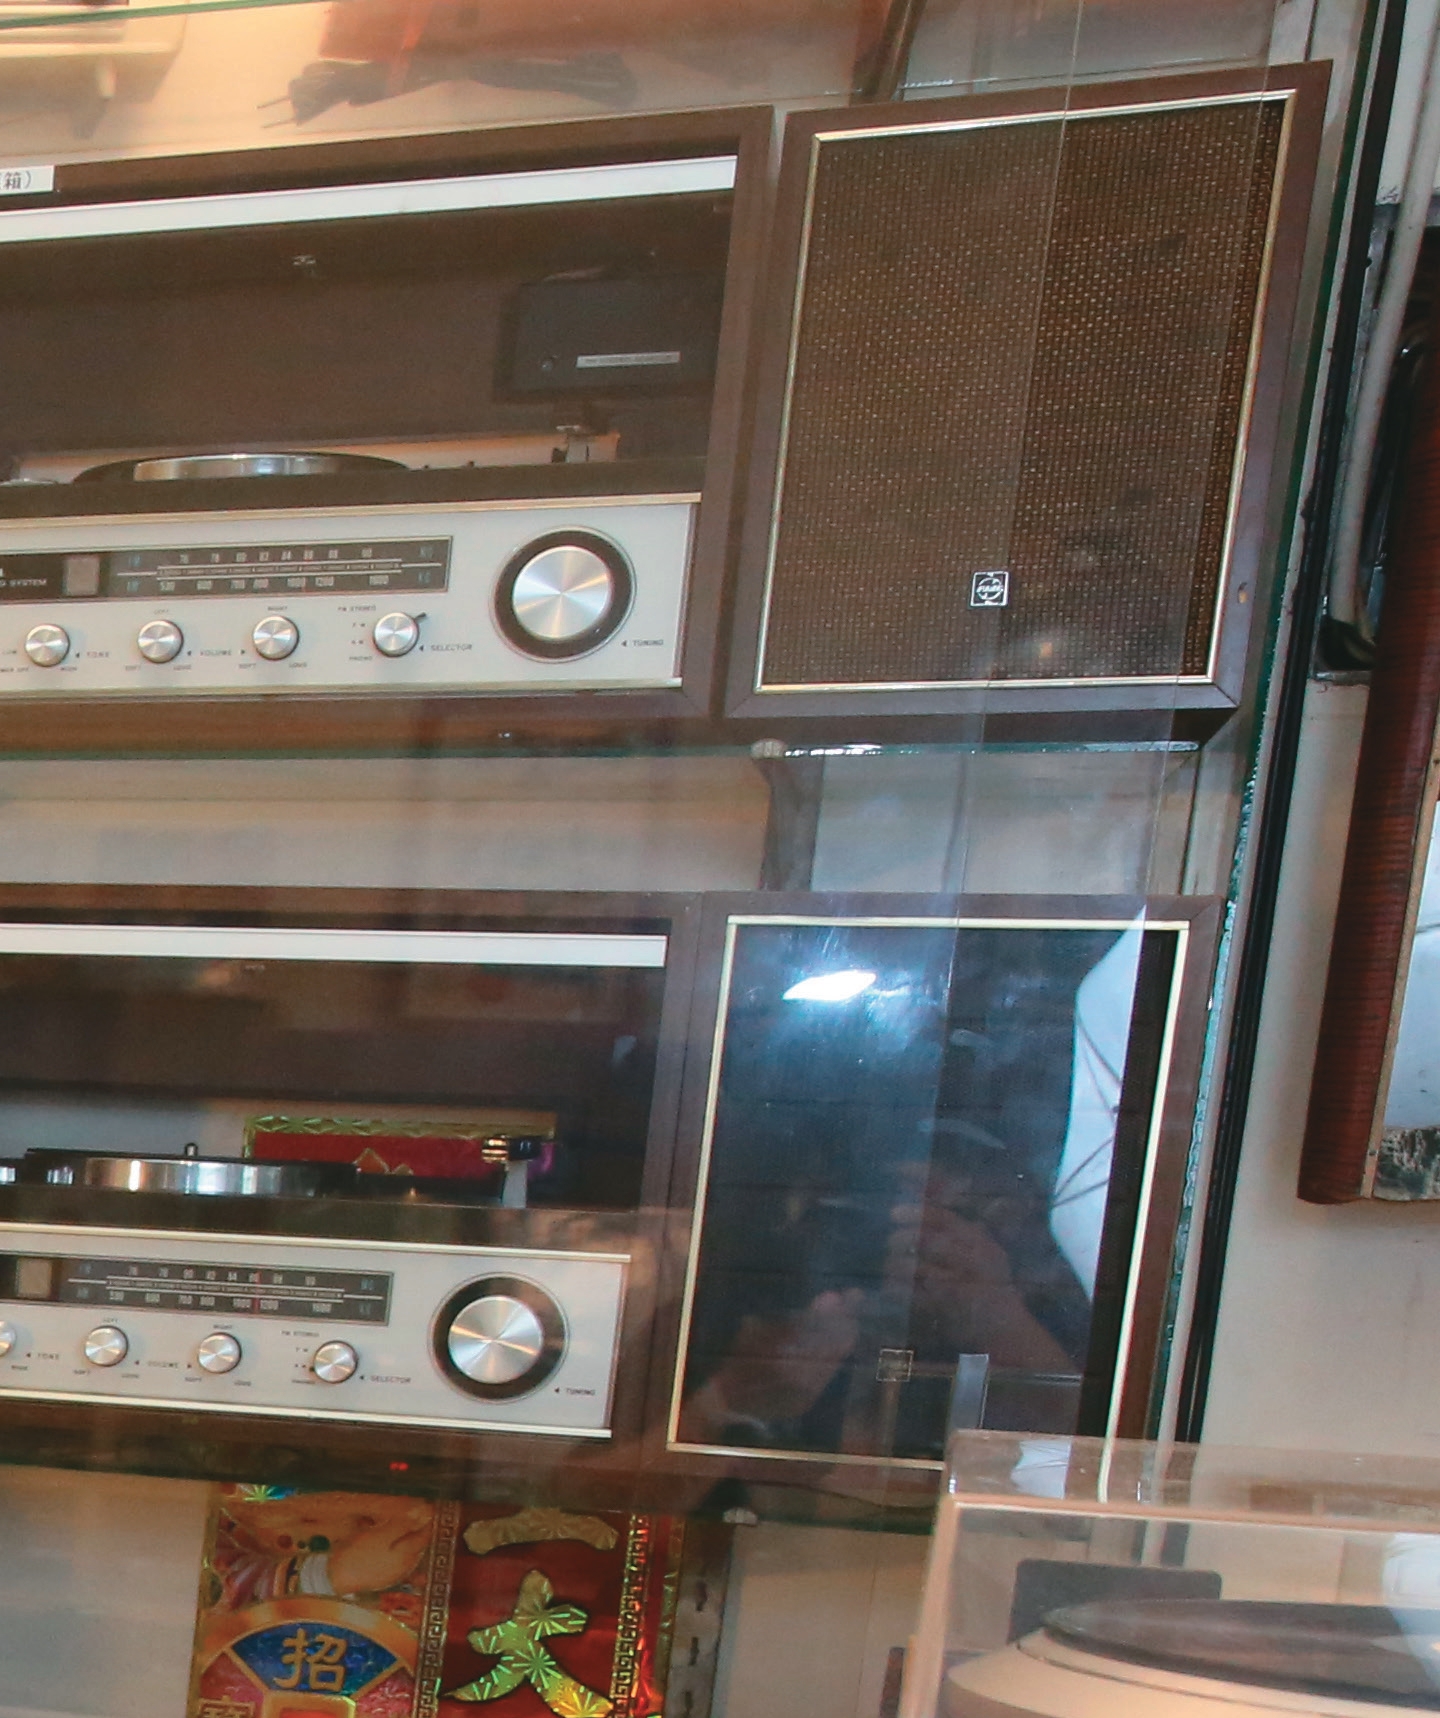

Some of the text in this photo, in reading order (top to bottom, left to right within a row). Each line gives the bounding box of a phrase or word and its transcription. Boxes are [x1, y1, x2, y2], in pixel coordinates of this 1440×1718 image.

[10, 578, 47, 587] SYSTEM
[431, 644, 472, 652] SELECTOR
[371, 1375, 411, 1383] SELECTOR
[274, 1628, 348, 1692] 招
